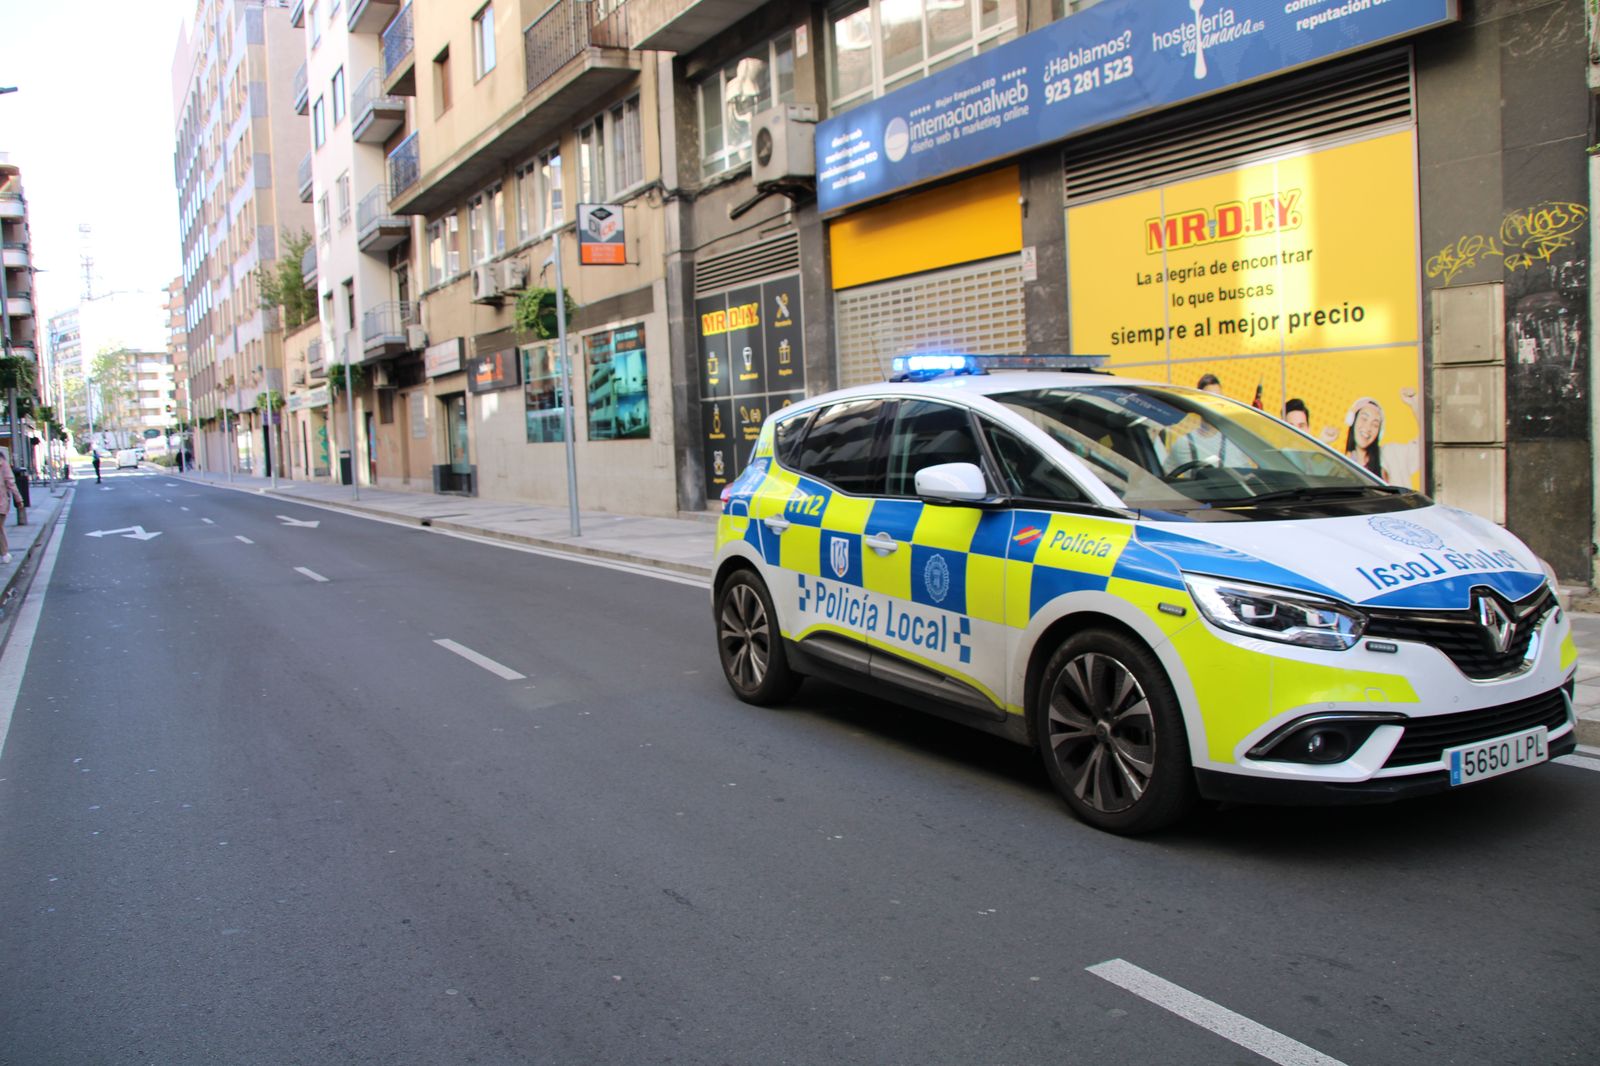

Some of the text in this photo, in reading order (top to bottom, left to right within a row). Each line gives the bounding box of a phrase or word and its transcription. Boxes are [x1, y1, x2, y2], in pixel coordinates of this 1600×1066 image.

[1296, 0, 1371, 31] reputación
[1043, 29, 1132, 83] ¿Hablamos?
[1045, 55, 1134, 105] 923 281 523
[909, 79, 1029, 141] internacionalweb
[962, 114, 1001, 137] marketing
[1003, 105, 1030, 122] online
[1136, 248, 1314, 286] La alegría de encontrar
[1171, 282, 1275, 308] lo que buscas
[1110, 302, 1366, 346] siempre al mejor precio
[795, 495, 825, 516] 112
[1049, 529, 1112, 558] Policía
[815, 581, 947, 653] Policía Local
[1464, 733, 1544, 776] 5650 LPL
